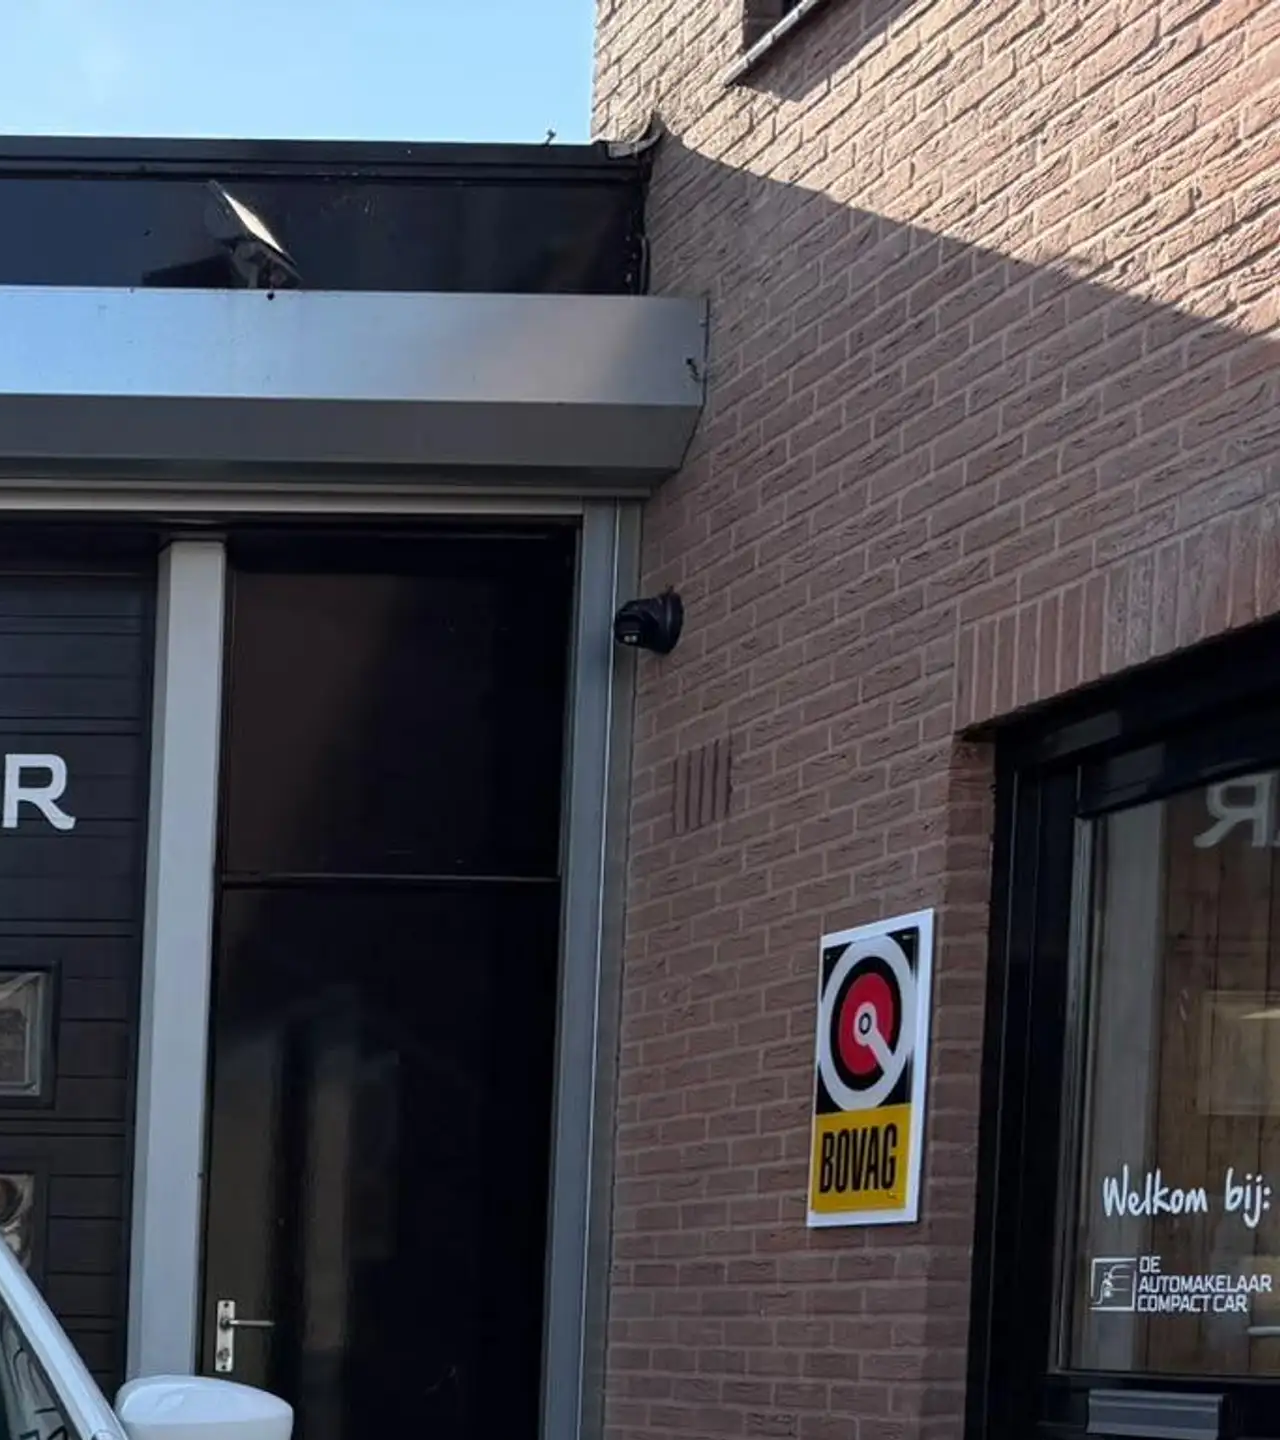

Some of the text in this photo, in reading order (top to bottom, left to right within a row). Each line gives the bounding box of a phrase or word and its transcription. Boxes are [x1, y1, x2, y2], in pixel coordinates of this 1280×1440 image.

[819, 1123, 898, 1194] BOVAG
[1103, 1164, 1271, 1228] Welkom bij:
[1139, 1256, 1161, 1273] DE
[1138, 1275, 1272, 1293] AUTOMAKELAAR
[1138, 1295, 1248, 1312] COMPACT CAR
